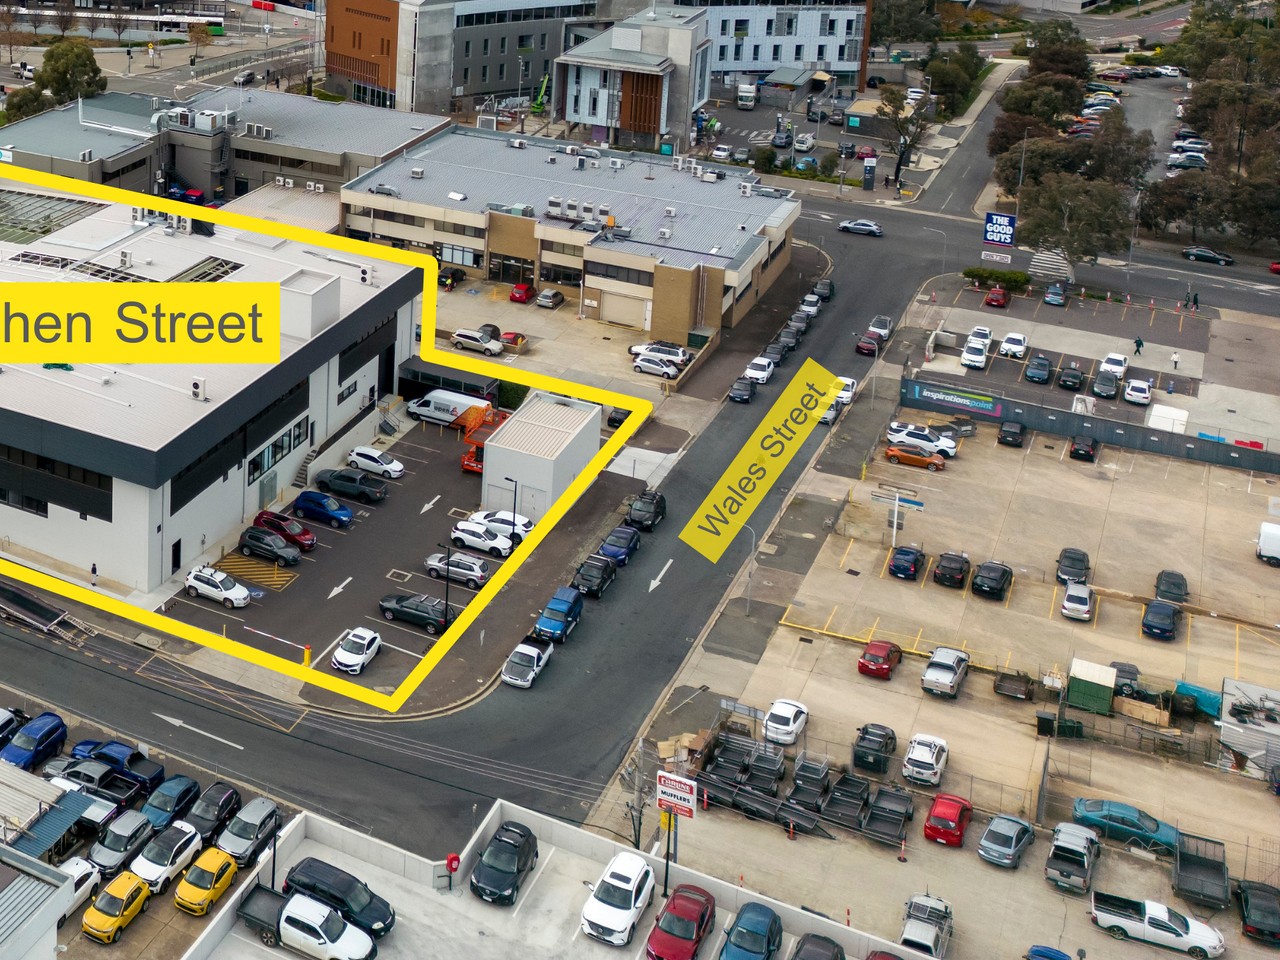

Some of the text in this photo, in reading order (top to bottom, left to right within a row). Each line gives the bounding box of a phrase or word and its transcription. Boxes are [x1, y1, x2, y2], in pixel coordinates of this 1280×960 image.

[992, 215, 1010, 225] THE
[986, 223, 1013, 234] GOOD
[986, 232, 1011, 243] GUYS
[660, 789, 691, 804] MUFFLERS
